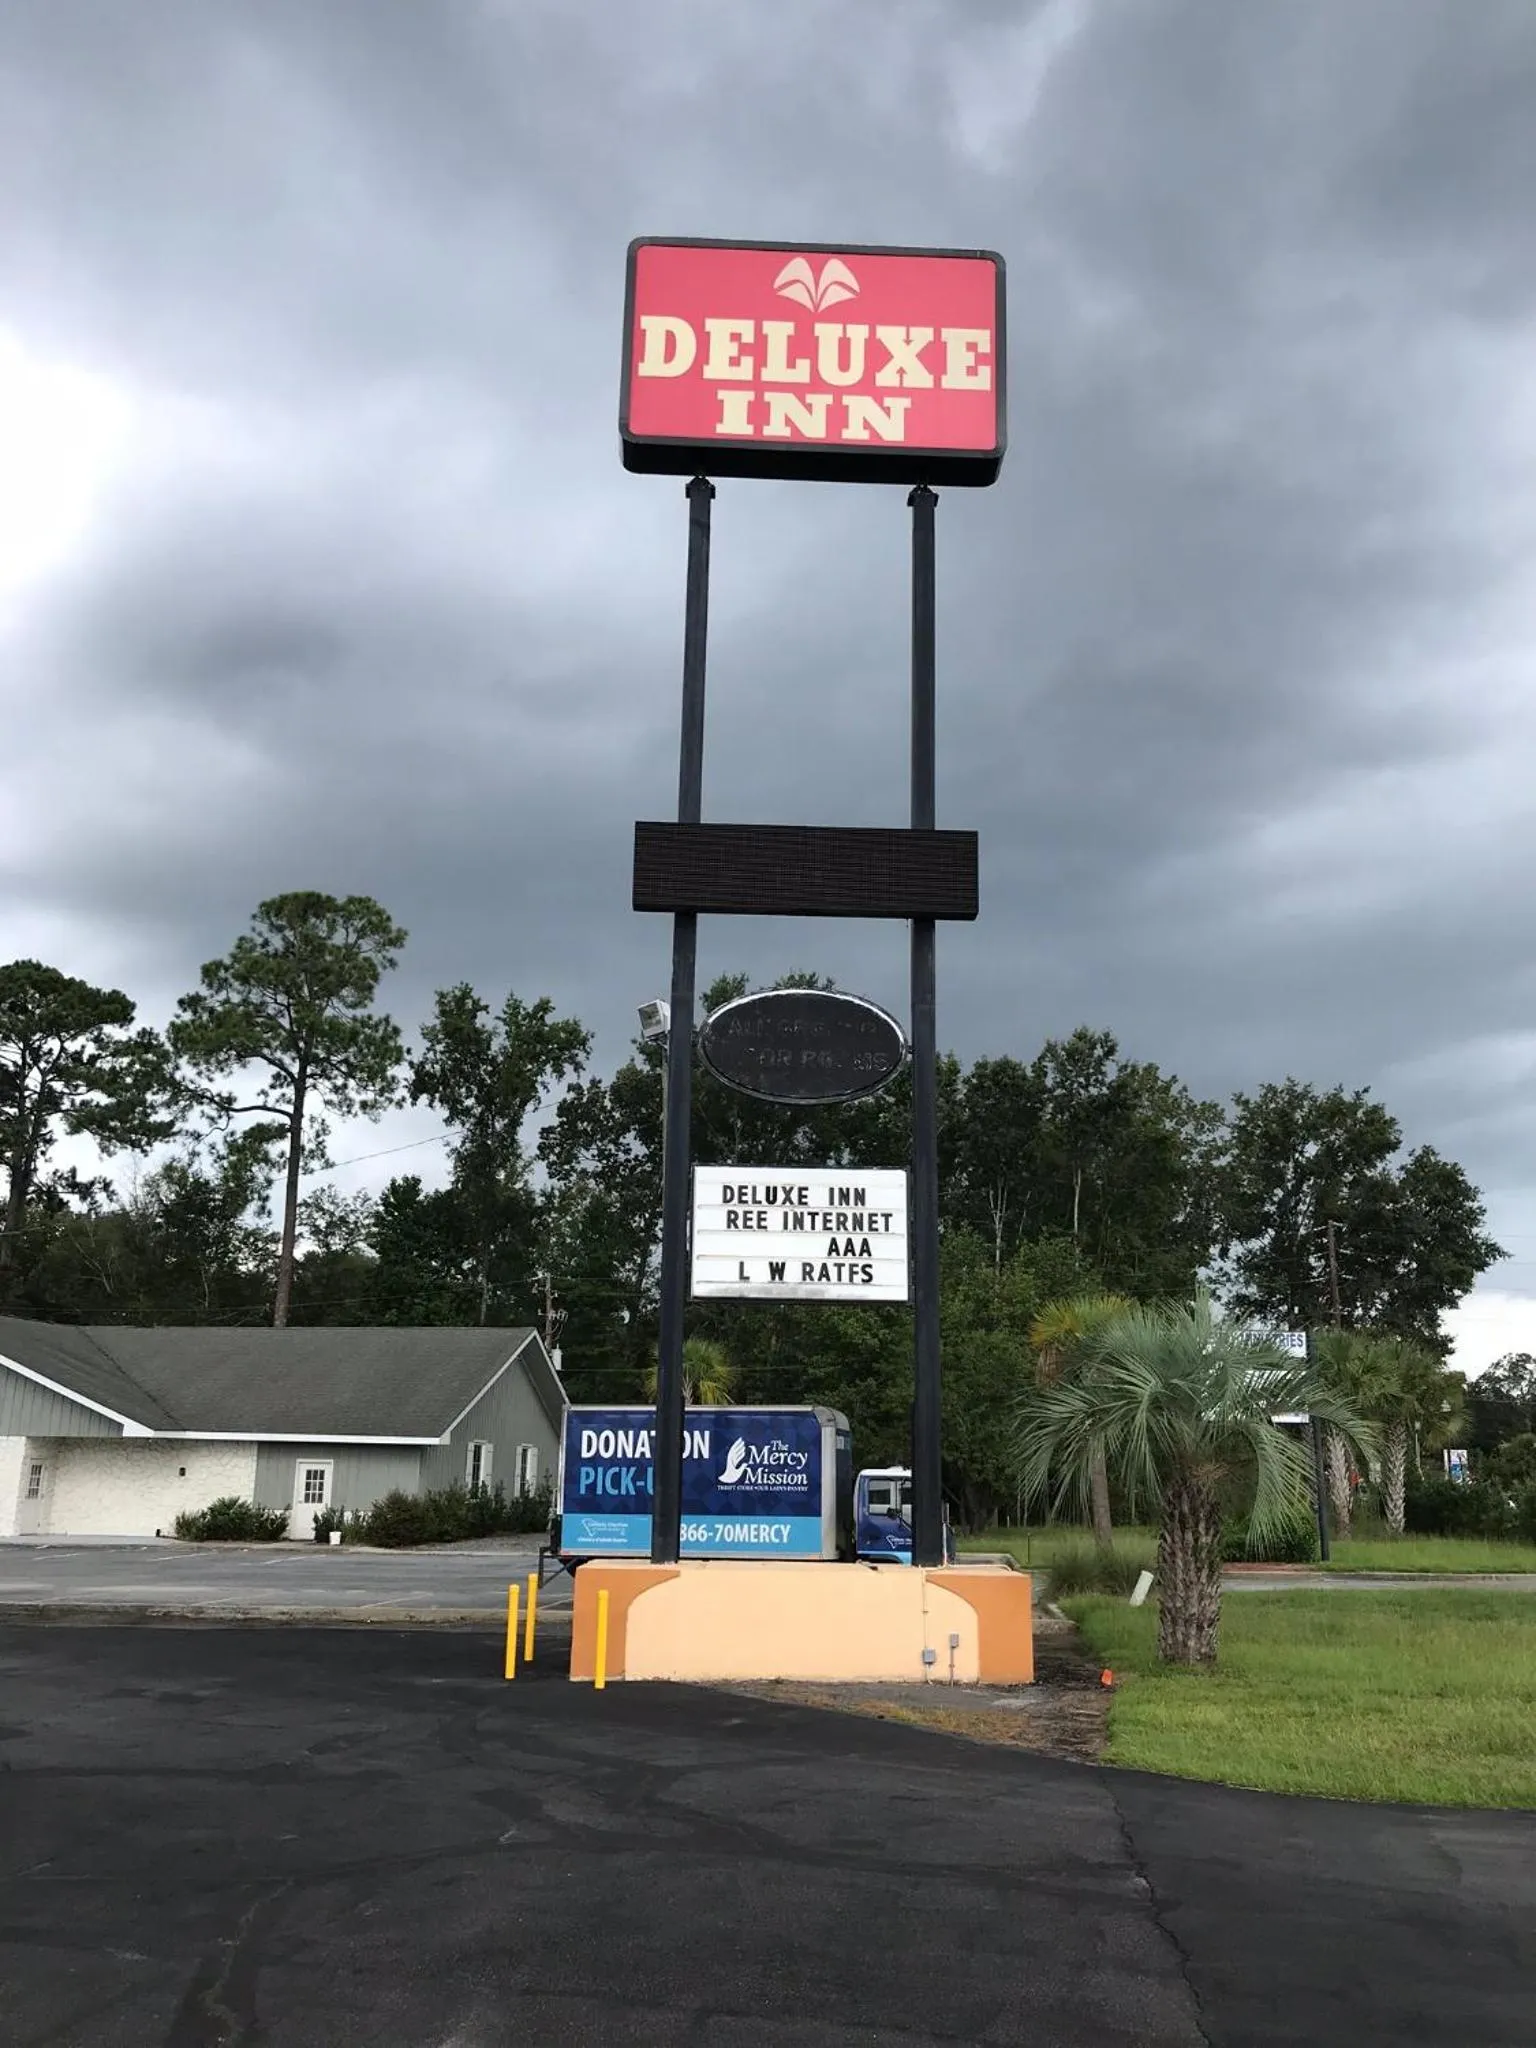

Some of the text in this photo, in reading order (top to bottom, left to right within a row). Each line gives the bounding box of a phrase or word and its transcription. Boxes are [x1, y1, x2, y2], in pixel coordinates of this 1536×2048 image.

[638, 315, 991, 391] DELUXE
[715, 389, 911, 441] INN
[722, 1184, 866, 1207] DELUXE INN
[726, 1210, 893, 1232] REE INTERNET
[827, 1237, 872, 1257] AAA
[772, 1440, 789, 1451] The
[748, 1445, 808, 1470] Mercy
[745, 1467, 808, 1485] Mission
